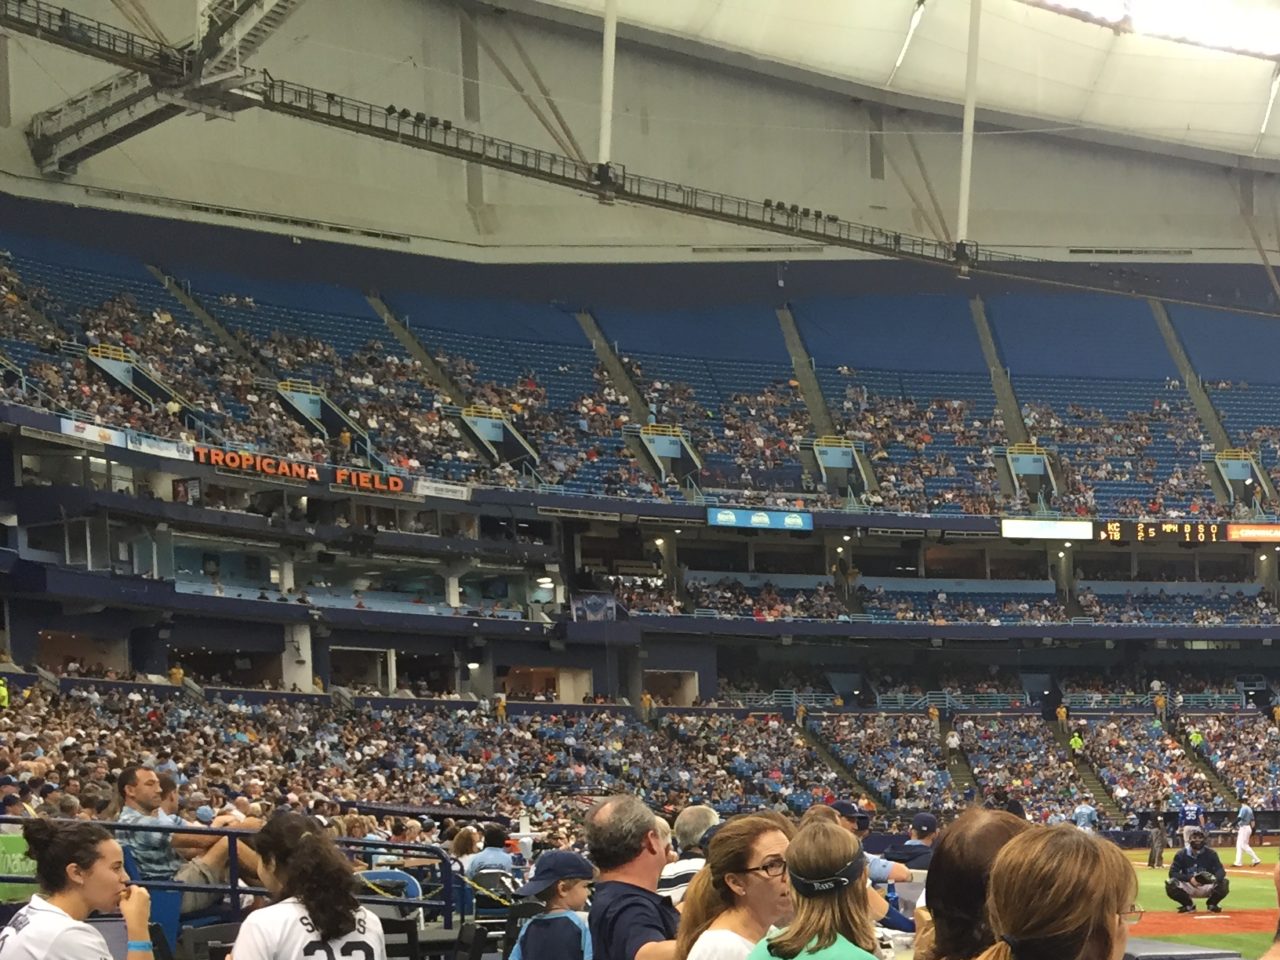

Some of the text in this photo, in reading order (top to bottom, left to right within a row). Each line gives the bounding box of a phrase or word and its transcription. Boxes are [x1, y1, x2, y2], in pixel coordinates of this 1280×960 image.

[194, 446, 320, 482] TROPICANA
[335, 468, 404, 492] FIELD
[1107, 523, 1121, 532] KC
[1161, 524, 1179, 533] MPH
[1184, 524, 1191, 533] B
[1197, 524, 1205, 533] S
[1107, 532, 1121, 541] TB
[1148, 528, 1156, 538] 5
[1185, 533, 1191, 541] 1
[1211, 533, 1217, 541] 1
[1185, 810, 1197, 821] 35
